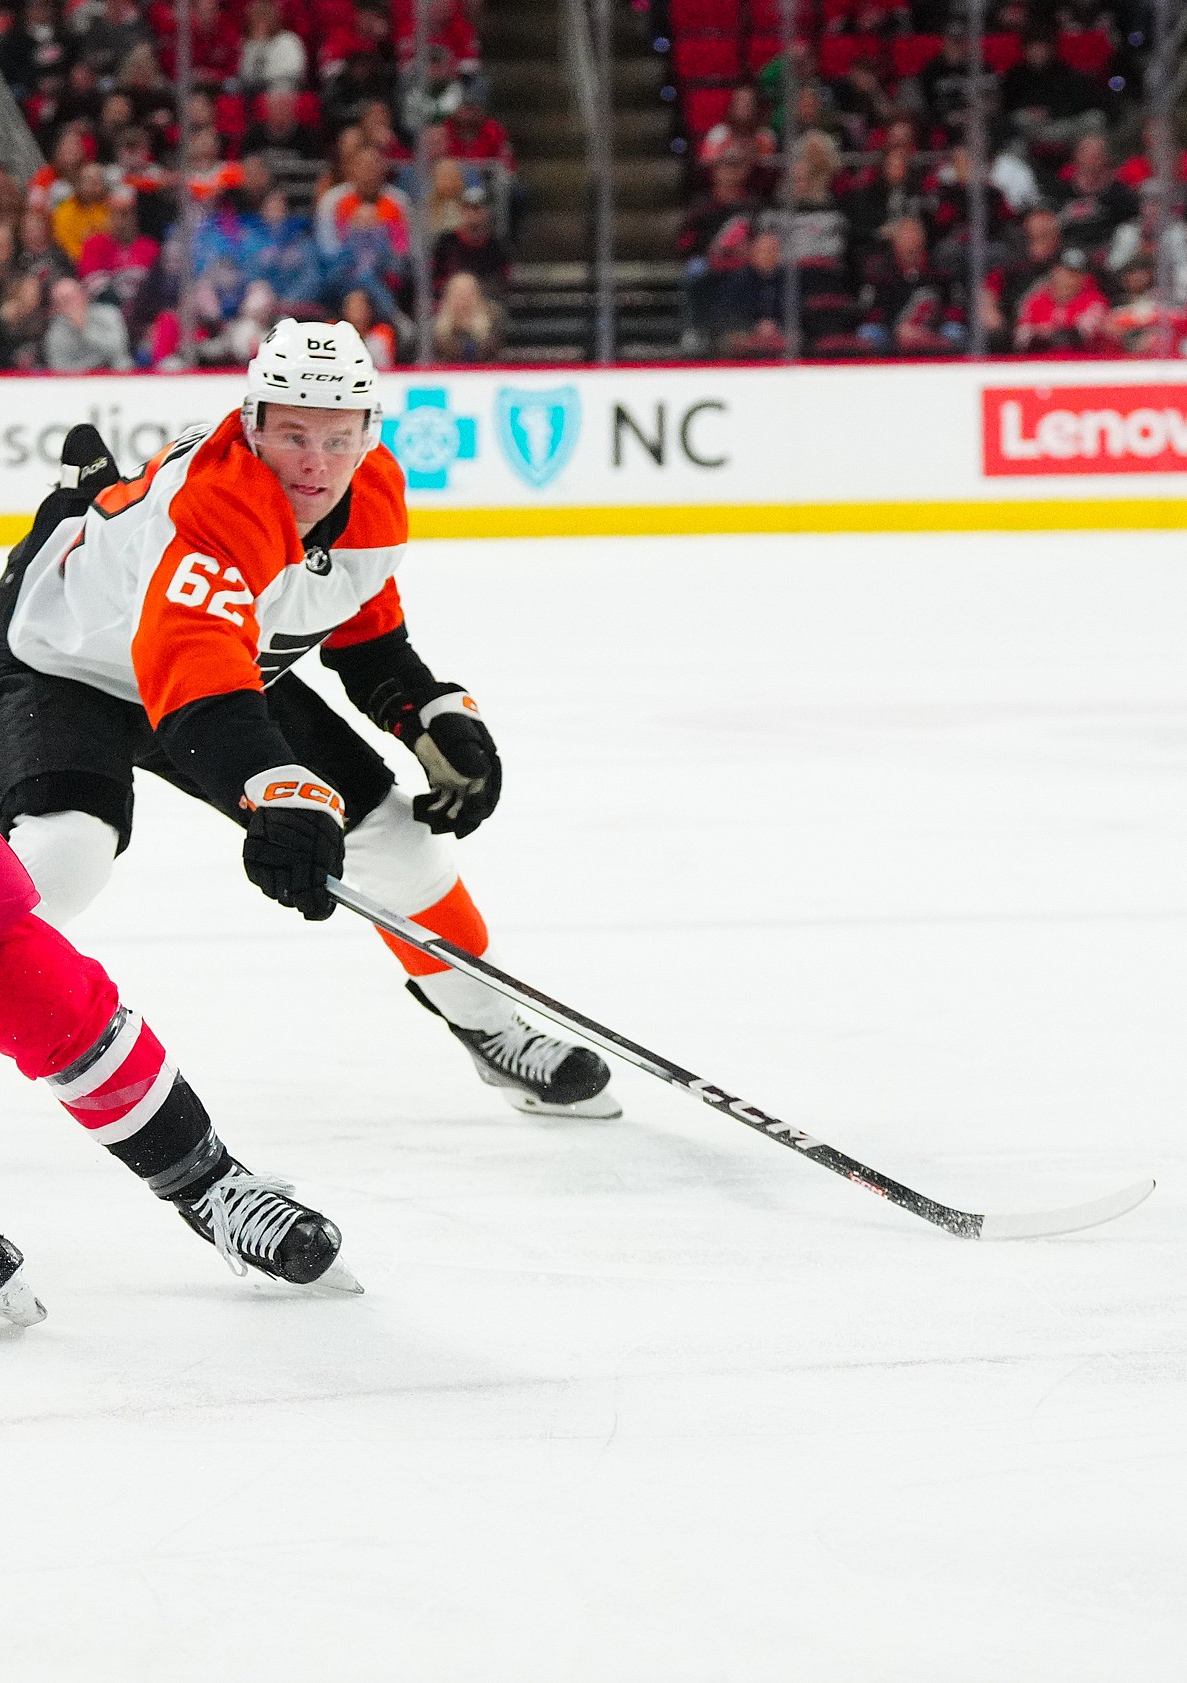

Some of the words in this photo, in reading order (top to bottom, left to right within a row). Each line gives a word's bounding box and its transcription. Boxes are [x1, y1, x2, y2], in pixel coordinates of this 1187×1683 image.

[301, 372, 344, 382] CCM
[609, 399, 730, 468] NC
[1000, 401, 1187, 461] Lenov
[165, 552, 254, 627] 62
[688, 1078, 825, 1150] CCM
